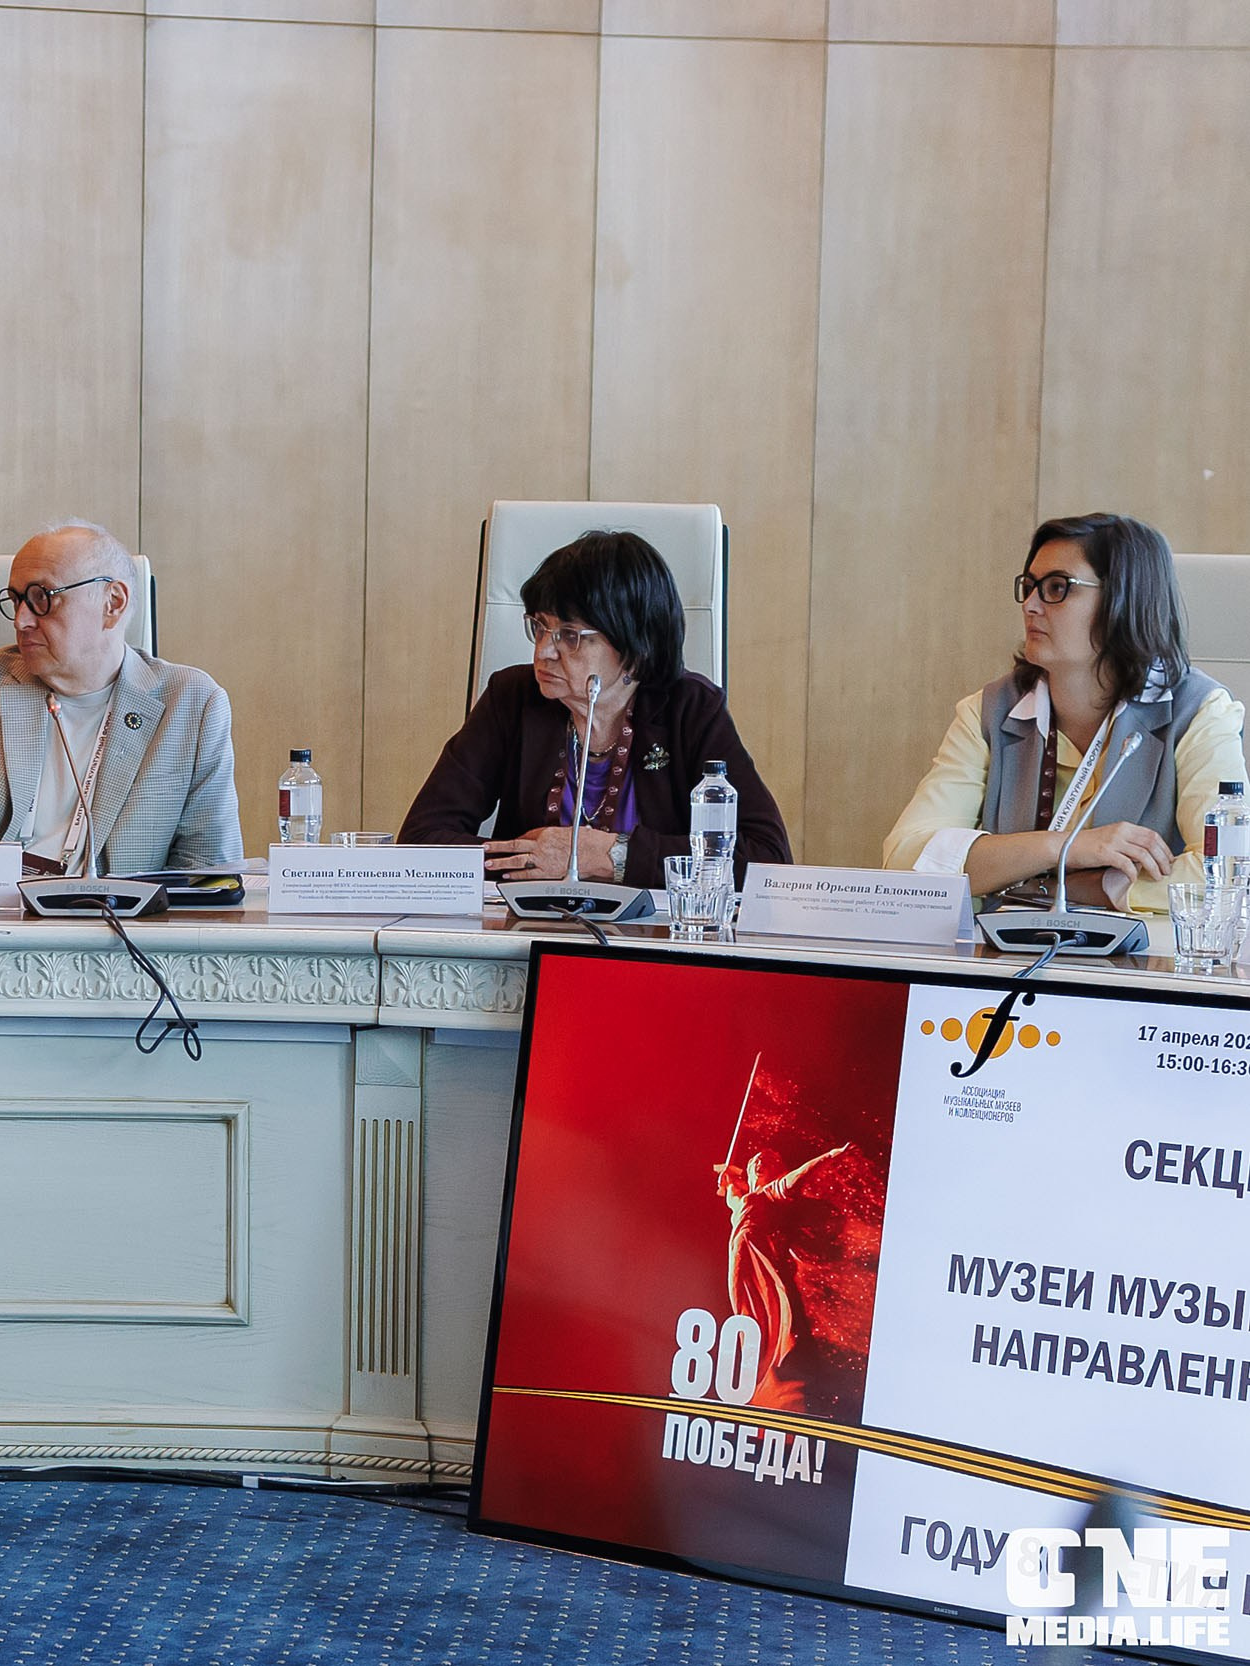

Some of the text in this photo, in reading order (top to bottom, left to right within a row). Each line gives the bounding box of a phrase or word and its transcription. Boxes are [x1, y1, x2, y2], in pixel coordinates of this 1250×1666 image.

[1062, 767, 1092, 817] КУЛЬТУРНЫЙ
[1086, 739, 1103, 768] ФОРУМ
[282, 869, 475, 879] Светлана Евгеньевна Мельникова
[79, 885, 110, 893] BOSCH
[560, 887, 590, 896] BOSCH
[764, 878, 948, 898] Валерия Юрьевна Евдокимова
[1046, 919, 1080, 928] BOSCH
[1138, 1026, 1158, 1042] 17
[1161, 1030, 1219, 1047] апреля
[1156, 1053, 1250, 1076] 15:00-16:3
[961, 1085, 1006, 1099] АССОЦИАЦИЯ
[943, 1095, 1022, 1112] МУЗЫКАЛЬНЫХ МУЗЕЕВ
[954, 1108, 1014, 1123] КОЛЛЕКЦИОНЕРОВ
[1124, 1139, 1250, 1199] СЕКЦ
[948, 1253, 1250, 1332] МУЗЕИ МУЗЫ
[671, 1308, 762, 1405] 80
[662, 1413, 826, 1486] ПОБЕДА!
[900, 1515, 1009, 1576] ГОДУ
